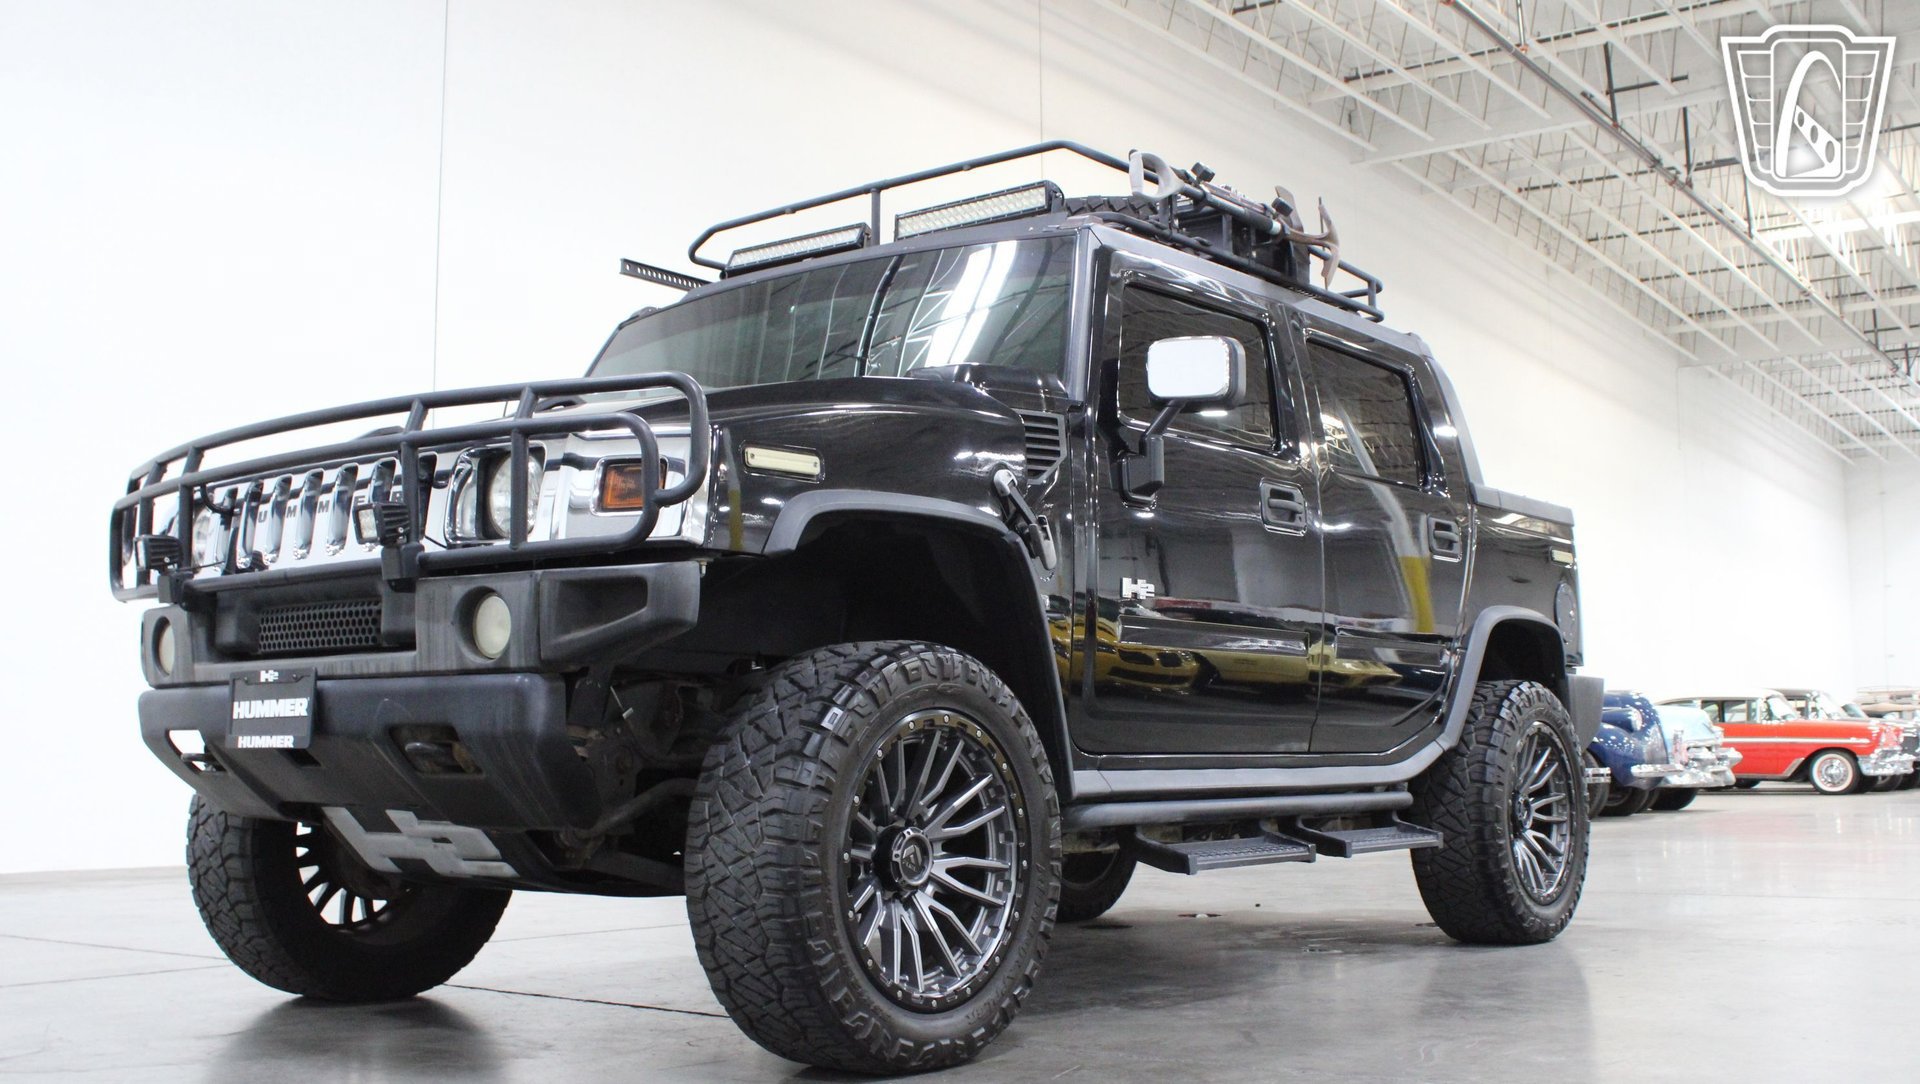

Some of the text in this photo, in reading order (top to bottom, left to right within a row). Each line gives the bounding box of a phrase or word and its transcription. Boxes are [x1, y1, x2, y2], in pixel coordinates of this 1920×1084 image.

[1122, 577, 1155, 600] H2
[260, 670, 279, 682] H2
[233, 698, 309, 719] HUMMER
[238, 736, 294, 749] HUMMER
